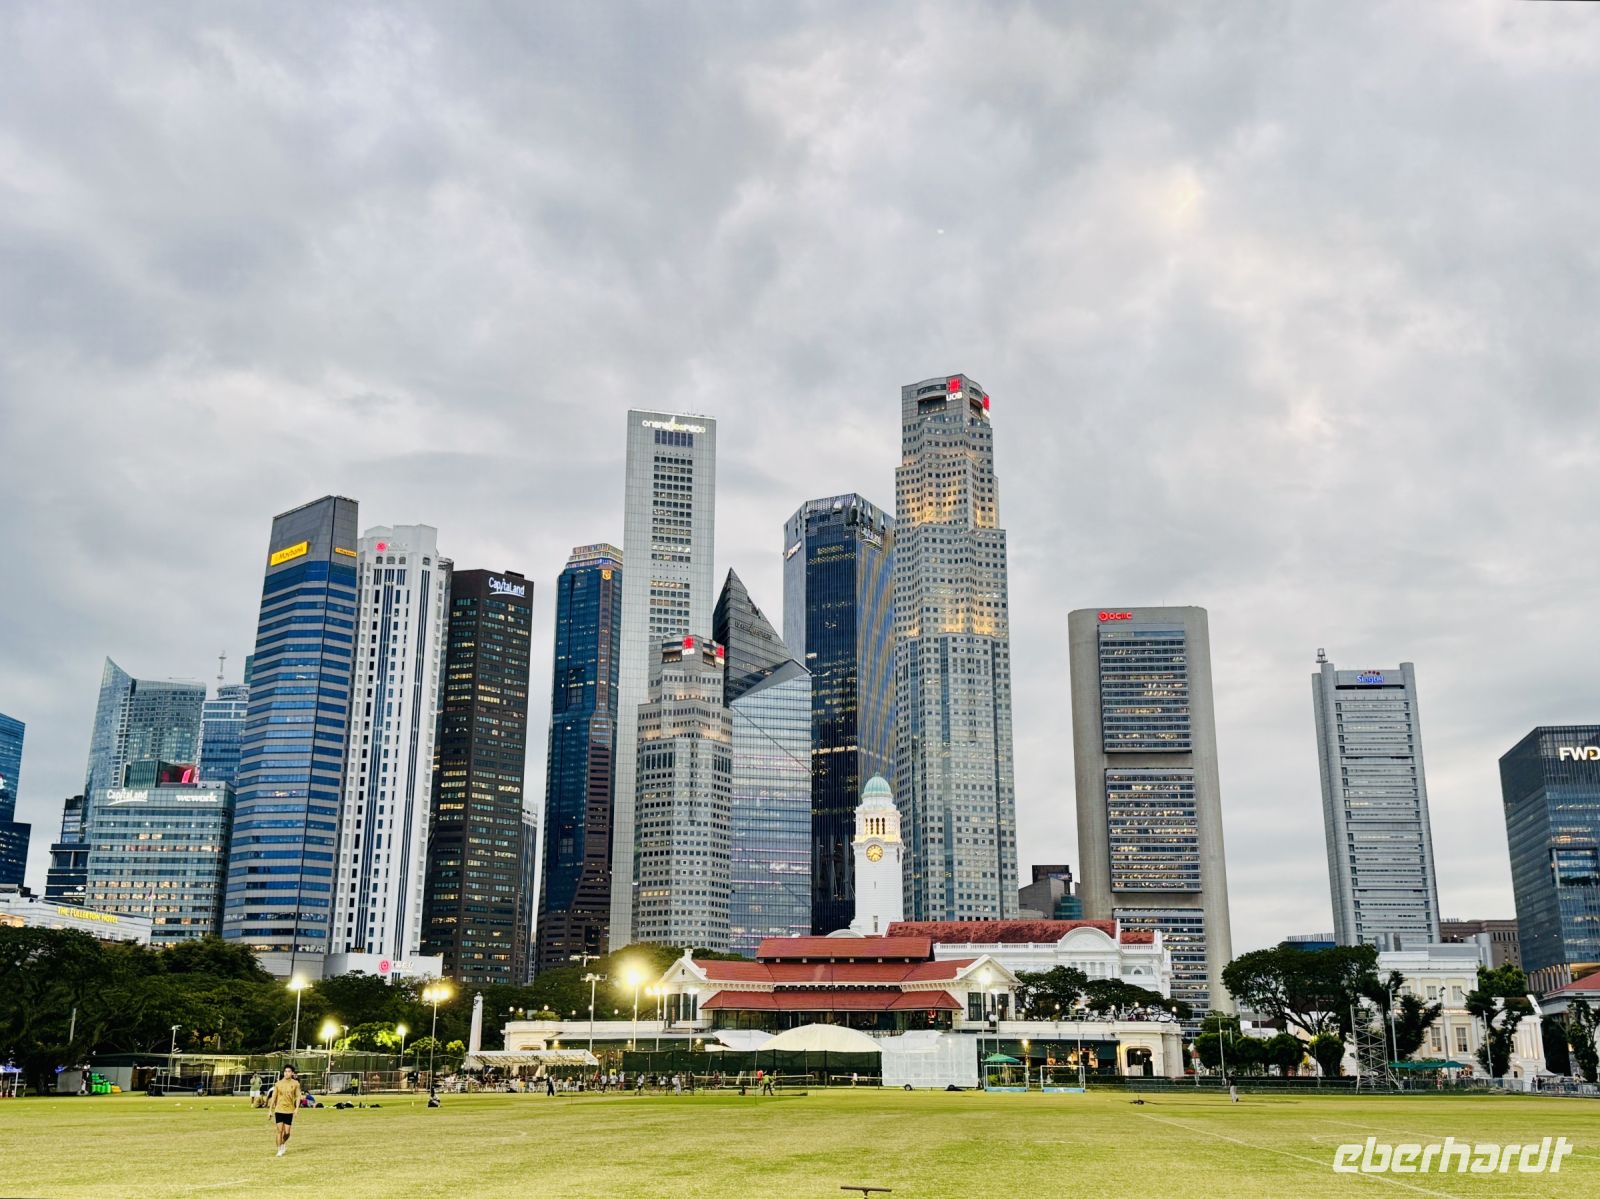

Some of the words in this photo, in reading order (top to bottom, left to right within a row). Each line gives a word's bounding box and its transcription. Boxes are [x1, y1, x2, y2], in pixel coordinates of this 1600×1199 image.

[946, 391, 963, 402] UOB
[488, 576, 526, 597] CapitaLand
[1559, 745, 1600, 762] FWD
[106, 788, 149, 803] CapitaLand
[57, 905, 69, 916] THE
[70, 907, 100, 921] FULLERTON
[101, 912, 119, 924] HOTEL
